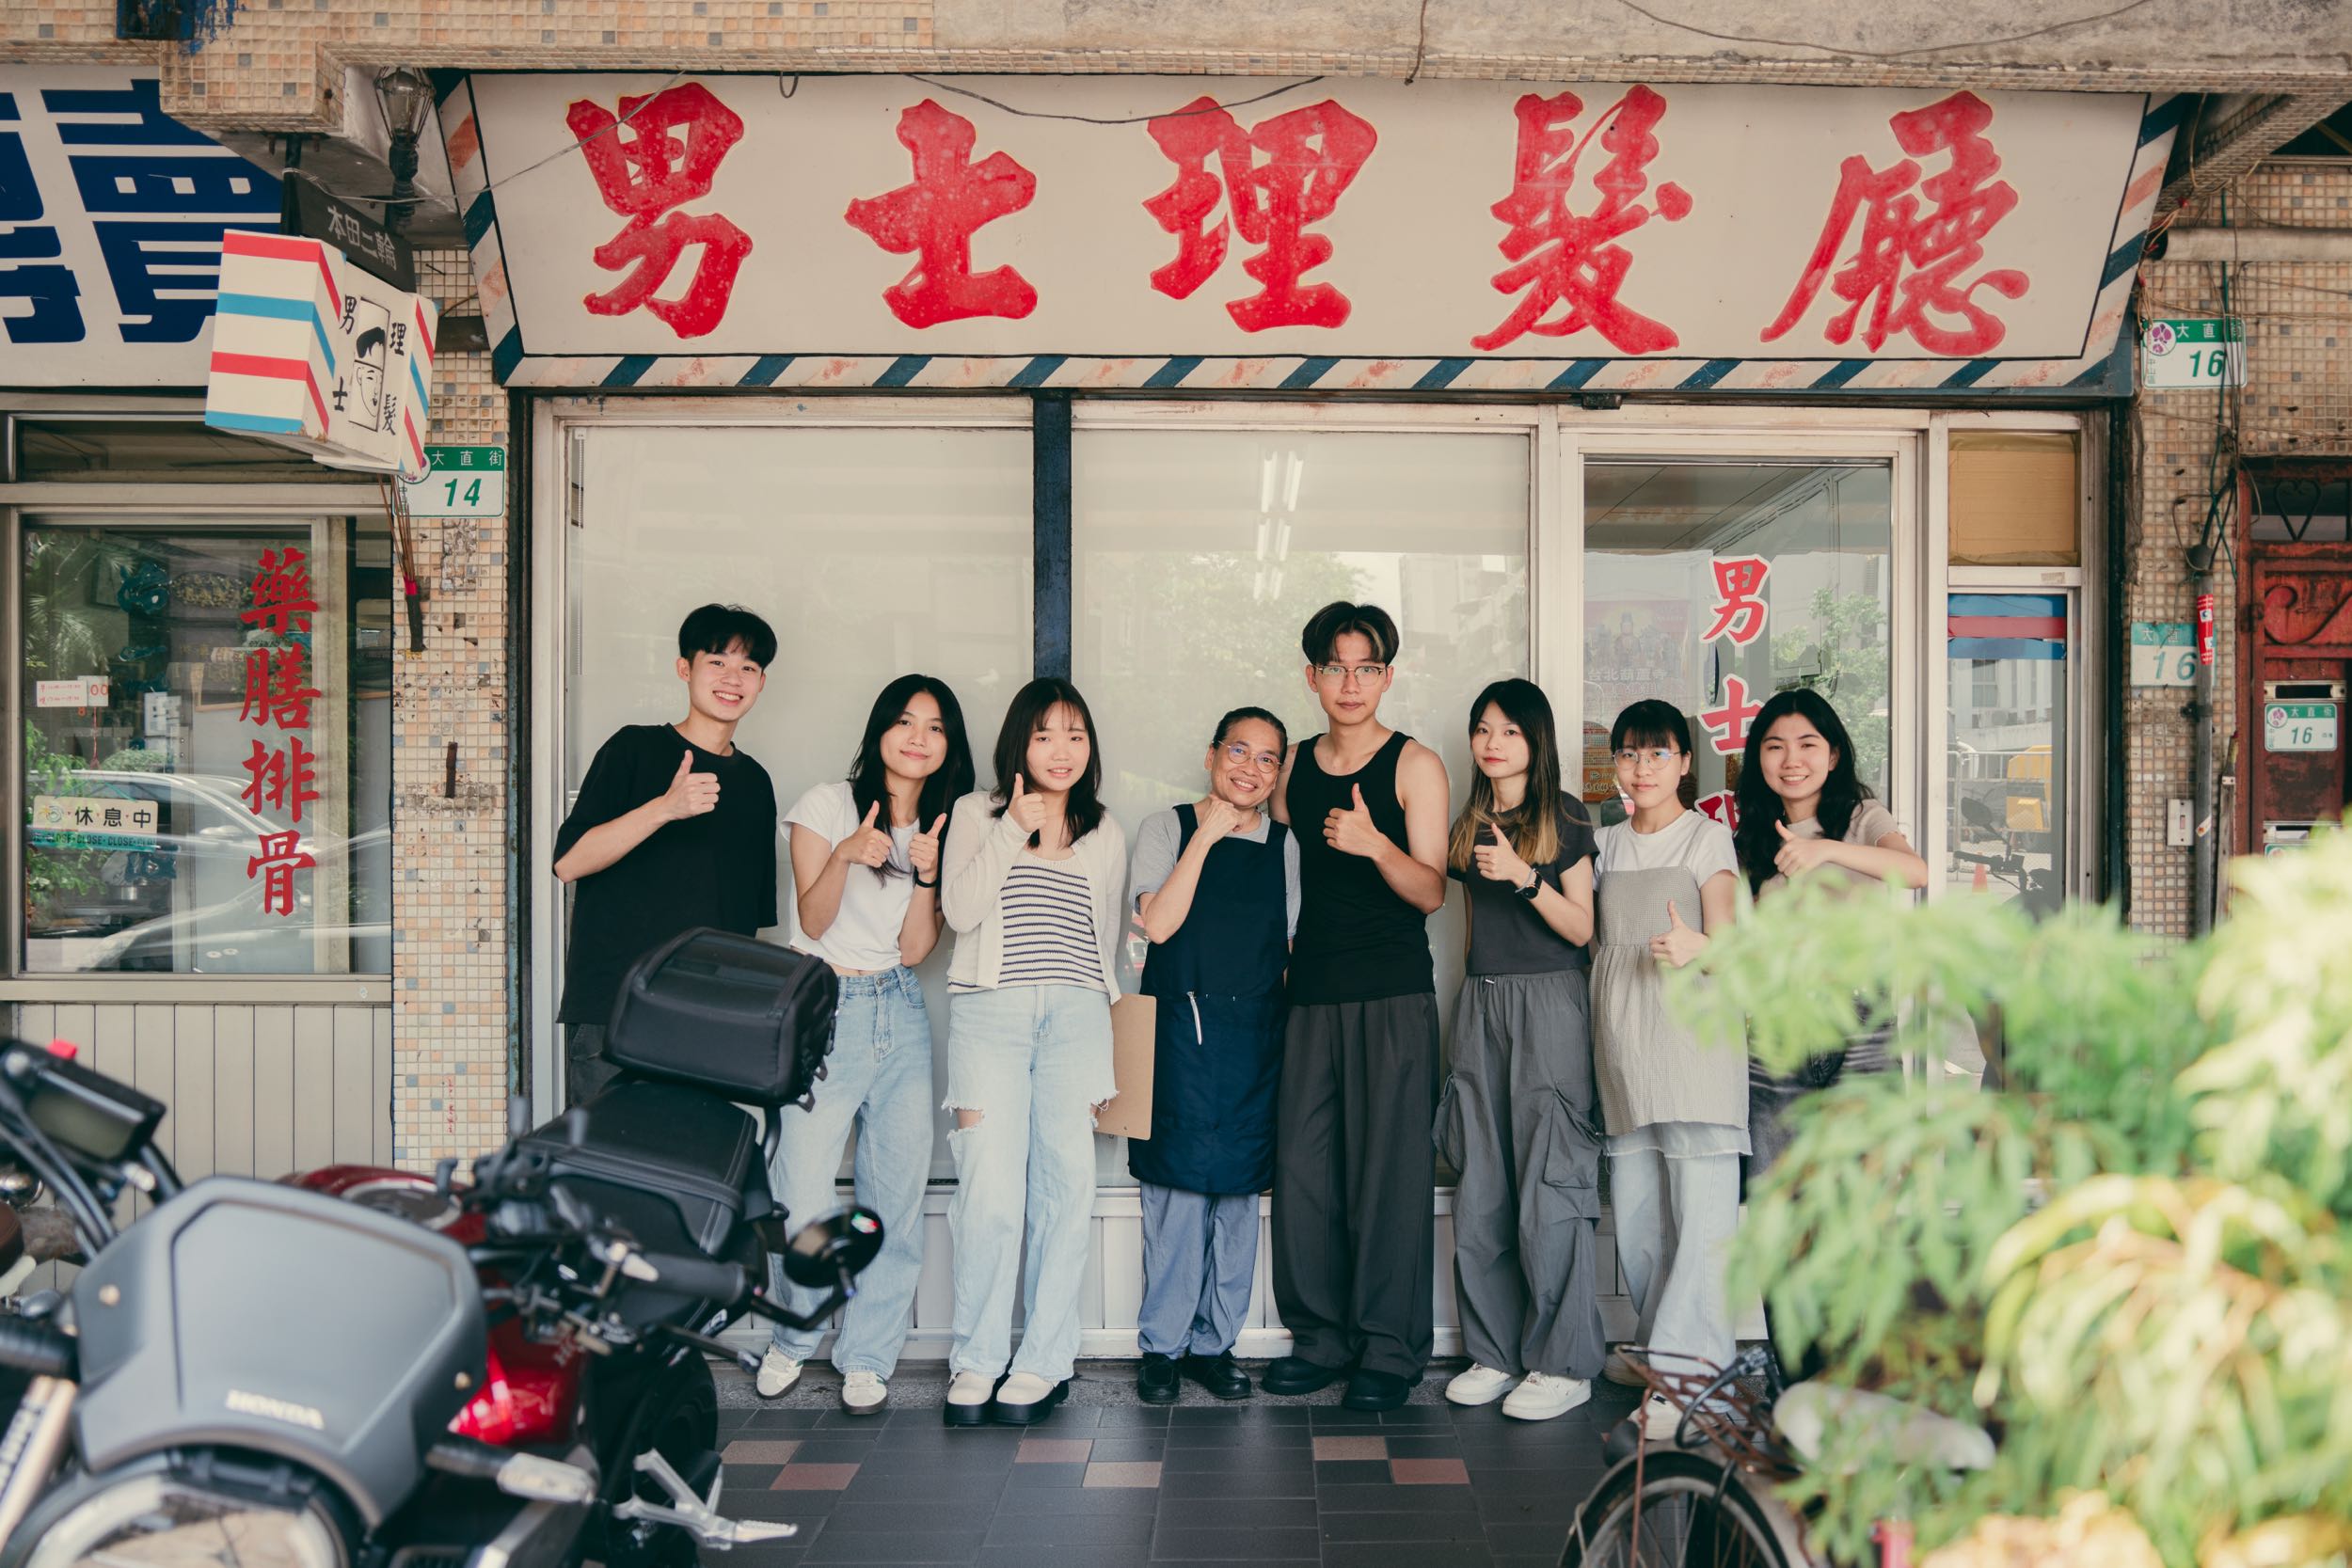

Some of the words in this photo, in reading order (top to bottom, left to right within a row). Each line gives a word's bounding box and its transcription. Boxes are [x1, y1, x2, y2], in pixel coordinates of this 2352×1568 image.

[566, 82, 2029, 357] 男士理髮廳
[327, 205, 396, 271] 本田二輪
[332, 294, 358, 412] 男士
[2189, 350, 2227, 377] 16
[382, 323, 406, 436] 理髮
[431, 451, 502, 467] 大直街
[444, 478, 482, 507] 14
[2153, 651, 2198, 680] 16
[239, 547, 322, 917] 藥膳排骨
[2292, 726, 2312, 744] 16
[74, 806, 151, 828] 休息中
[108, 836, 133, 847] CLOSE
